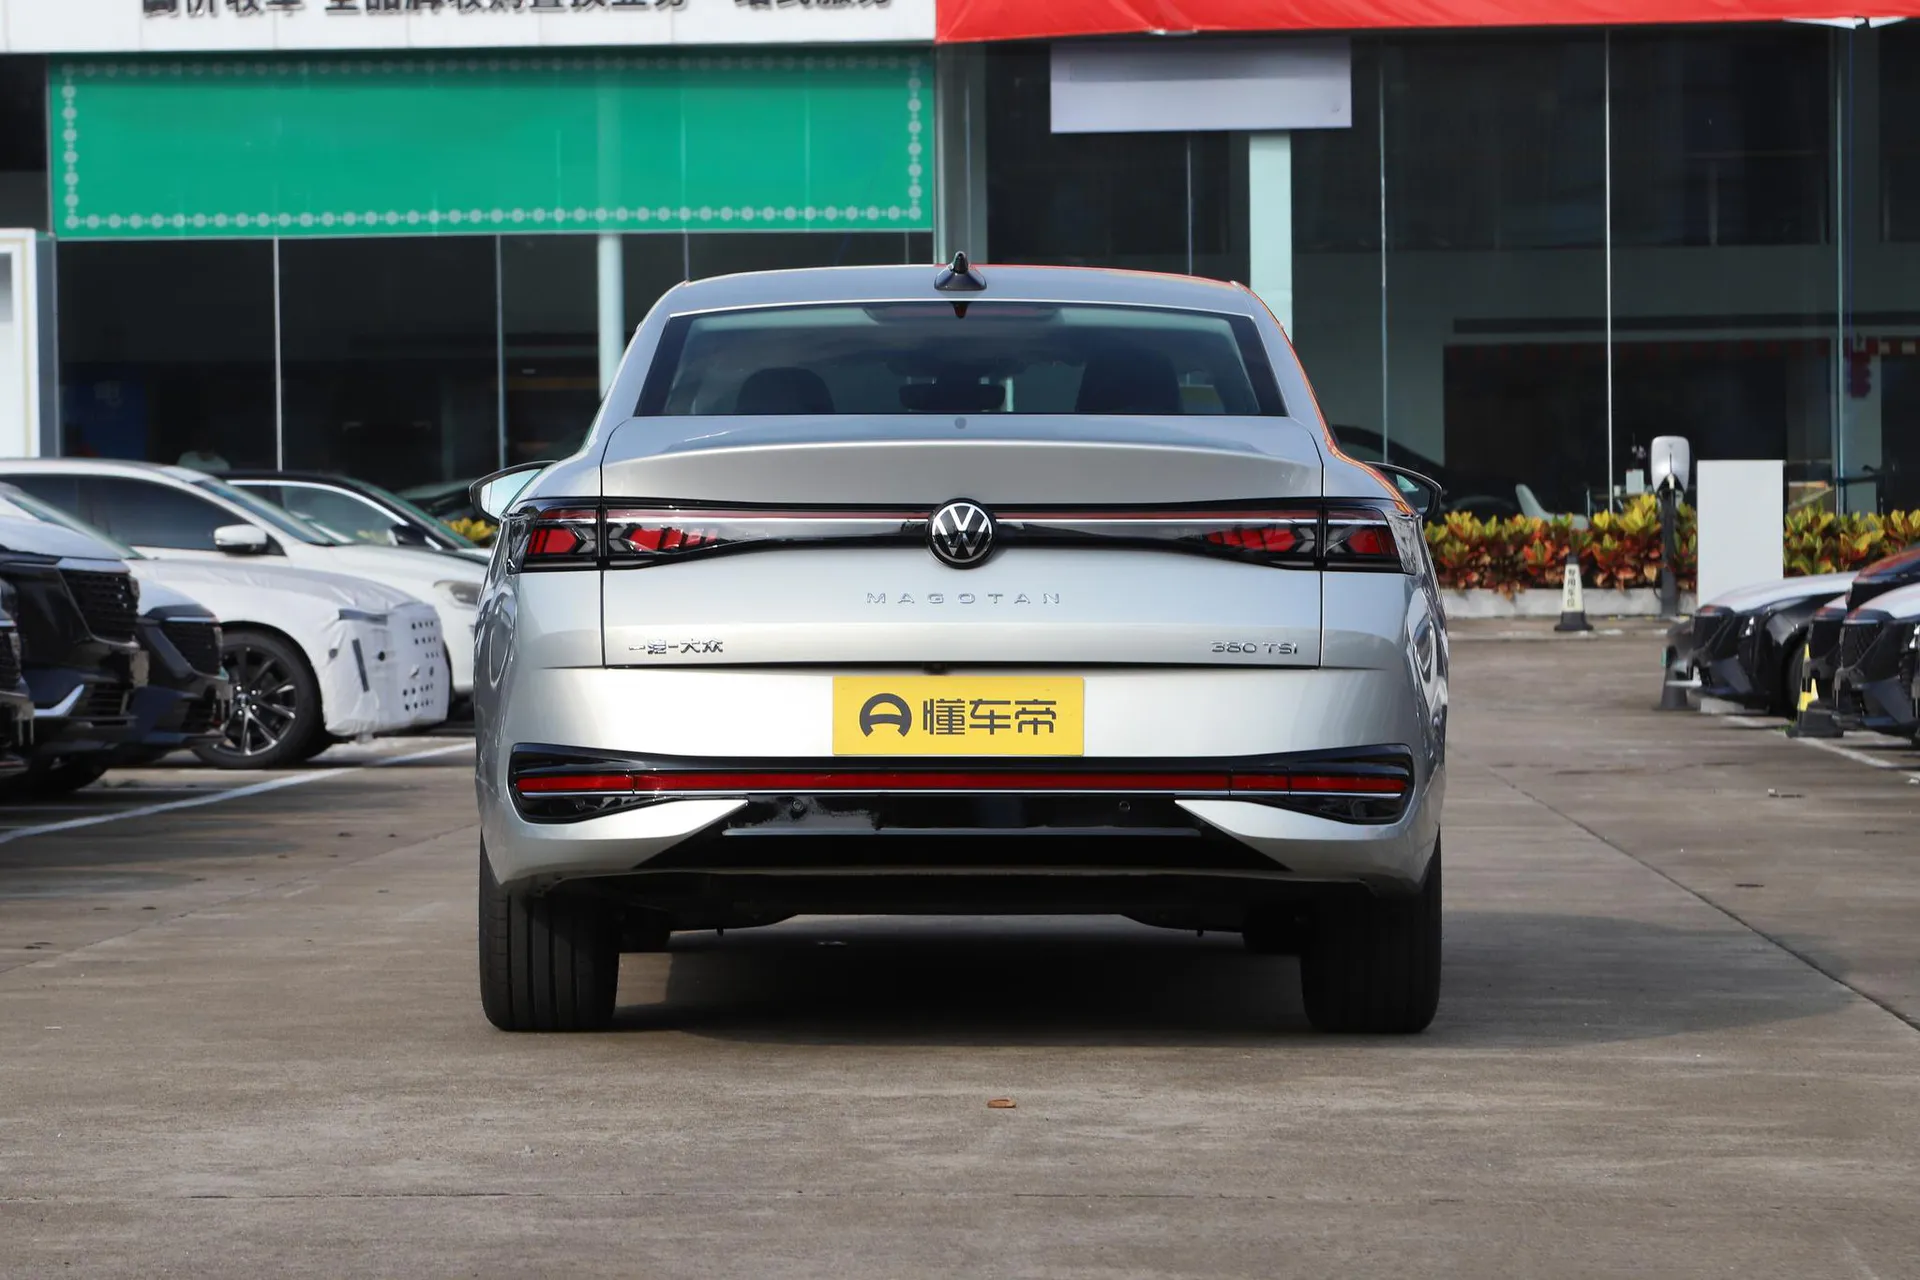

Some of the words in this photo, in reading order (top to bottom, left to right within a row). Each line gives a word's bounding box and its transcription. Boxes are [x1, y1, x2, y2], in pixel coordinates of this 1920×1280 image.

[866, 592, 1061, 605] MAGOTAN
[1211, 640, 1257, 654] 380
[1262, 641, 1298, 655] TSI
[922, 698, 1057, 736] 懂车帝
